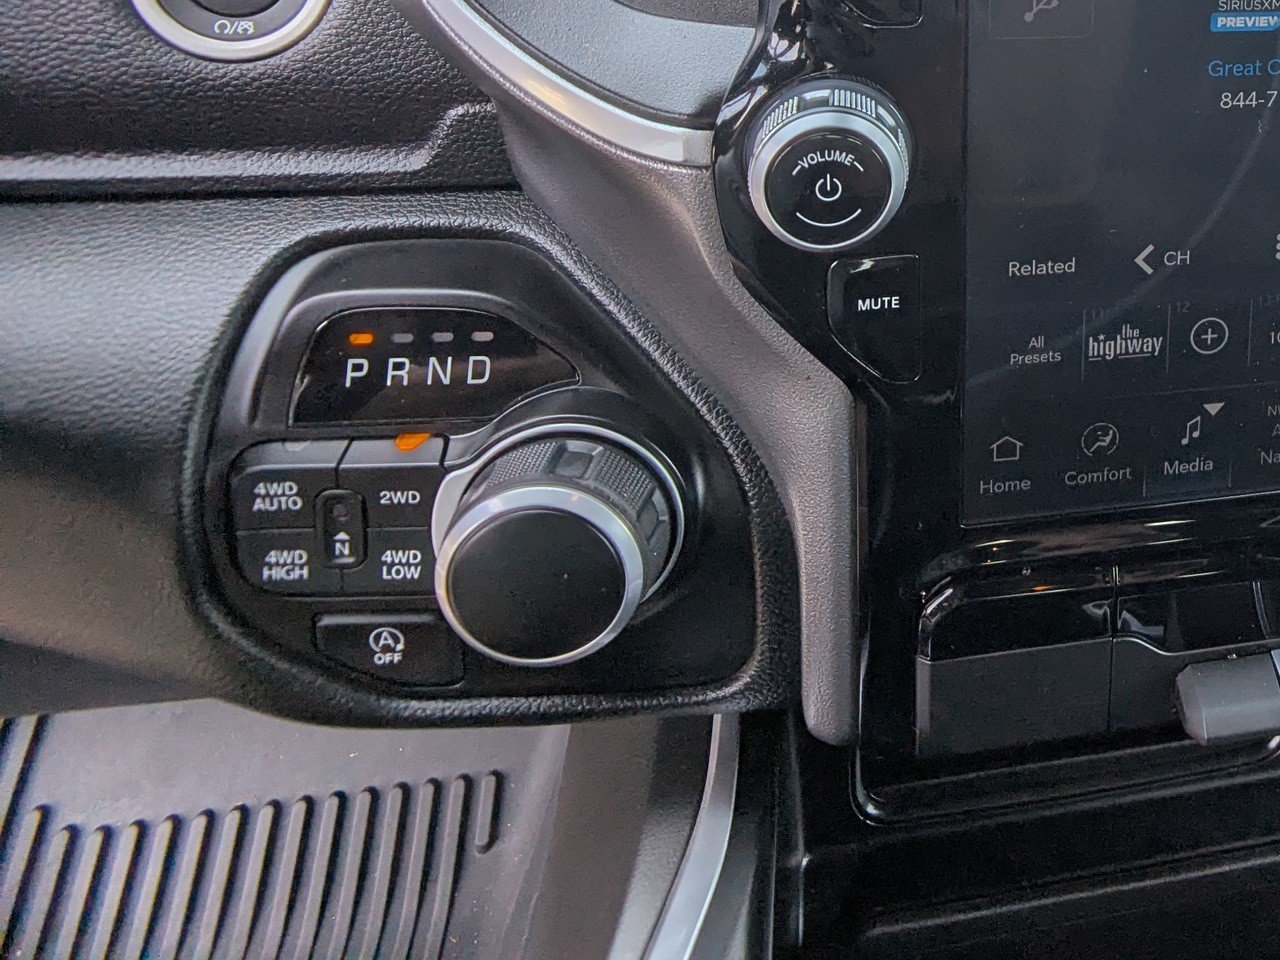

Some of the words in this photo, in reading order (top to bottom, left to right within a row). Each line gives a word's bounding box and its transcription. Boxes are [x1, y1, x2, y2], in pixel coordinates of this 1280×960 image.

[1208, 60, 1262, 77] Great
[798, 150, 855, 169] VOLUME
[1008, 257, 1076, 277] Related
[1163, 251, 1191, 267] CH
[858, 296, 900, 311] MUTE
[1121, 324, 1140, 338] the
[1028, 336, 1045, 348] All
[1088, 335, 1163, 360] highway
[1010, 351, 1061, 366] Presets
[344, 358, 370, 388] P
[386, 357, 410, 386] R
[427, 356, 452, 385] N
[466, 356, 491, 385] D
[1163, 457, 1213, 475] Media
[1064, 467, 1132, 486] Comfort
[254, 481, 299, 496] 4WD
[980, 479, 1031, 495] Home
[253, 496, 303, 512] AUTO
[379, 491, 420, 505] 2WD
[264, 550, 309, 564] 4WD
[381, 550, 422, 564] 4WD
[262, 565, 309, 581] HIGH
[382, 565, 422, 580] LOW
[373, 652, 403, 665] OFF
